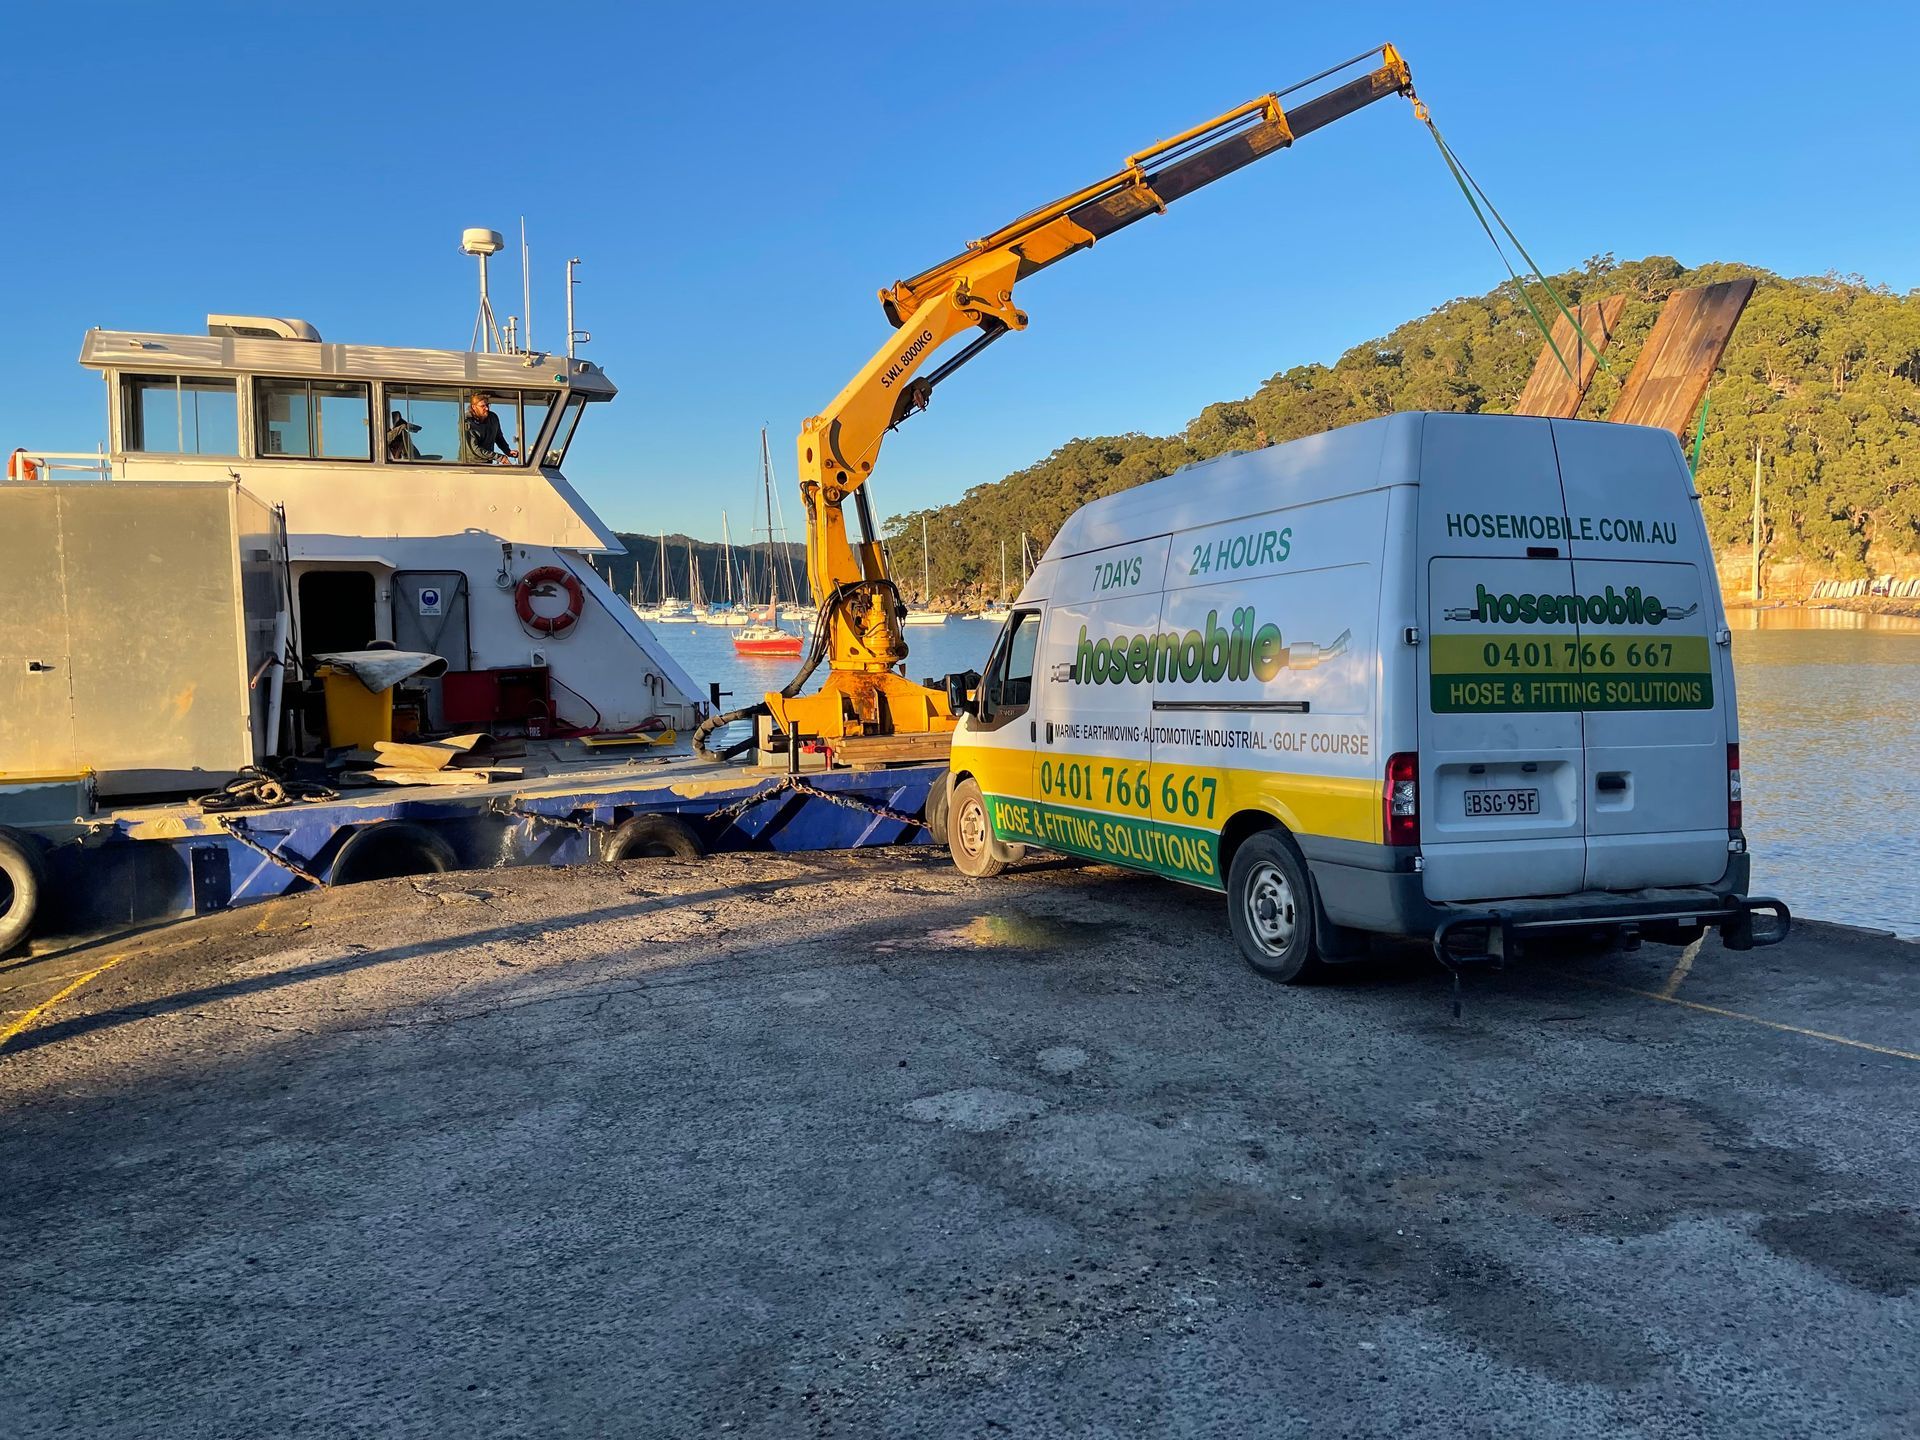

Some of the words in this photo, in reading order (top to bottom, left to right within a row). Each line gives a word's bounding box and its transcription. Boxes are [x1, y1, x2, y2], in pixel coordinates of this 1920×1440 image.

[900, 330, 933, 366] 8000KG
[1447, 513, 1677, 544] HOSEMOBILE.COM.AU
[1189, 543, 1213, 576] 24
[1215, 527, 1293, 572] HOURS
[1101, 556, 1142, 590] DAYS
[1476, 583, 1663, 625] hosemobile
[1075, 605, 1282, 685] hosemobile
[1483, 643, 1554, 667] 0401
[1564, 643, 1615, 667] 766
[1626, 643, 1673, 667] 667
[1450, 683, 1505, 705] HOSE
[1512, 682, 1525, 704] &
[1530, 682, 1600, 704] FITTING
[1606, 682, 1701, 703] SOLUTIONS
[1311, 733, 1369, 755] COURSE
[1041, 761, 1092, 800] 0401
[1103, 767, 1150, 809] 766
[1162, 773, 1218, 819] 667
[995, 802, 1033, 836] HOSE
[1033, 809, 1045, 839] &
[1046, 814, 1103, 851] FITTING
[1104, 822, 1214, 876] SOLUTIONS
